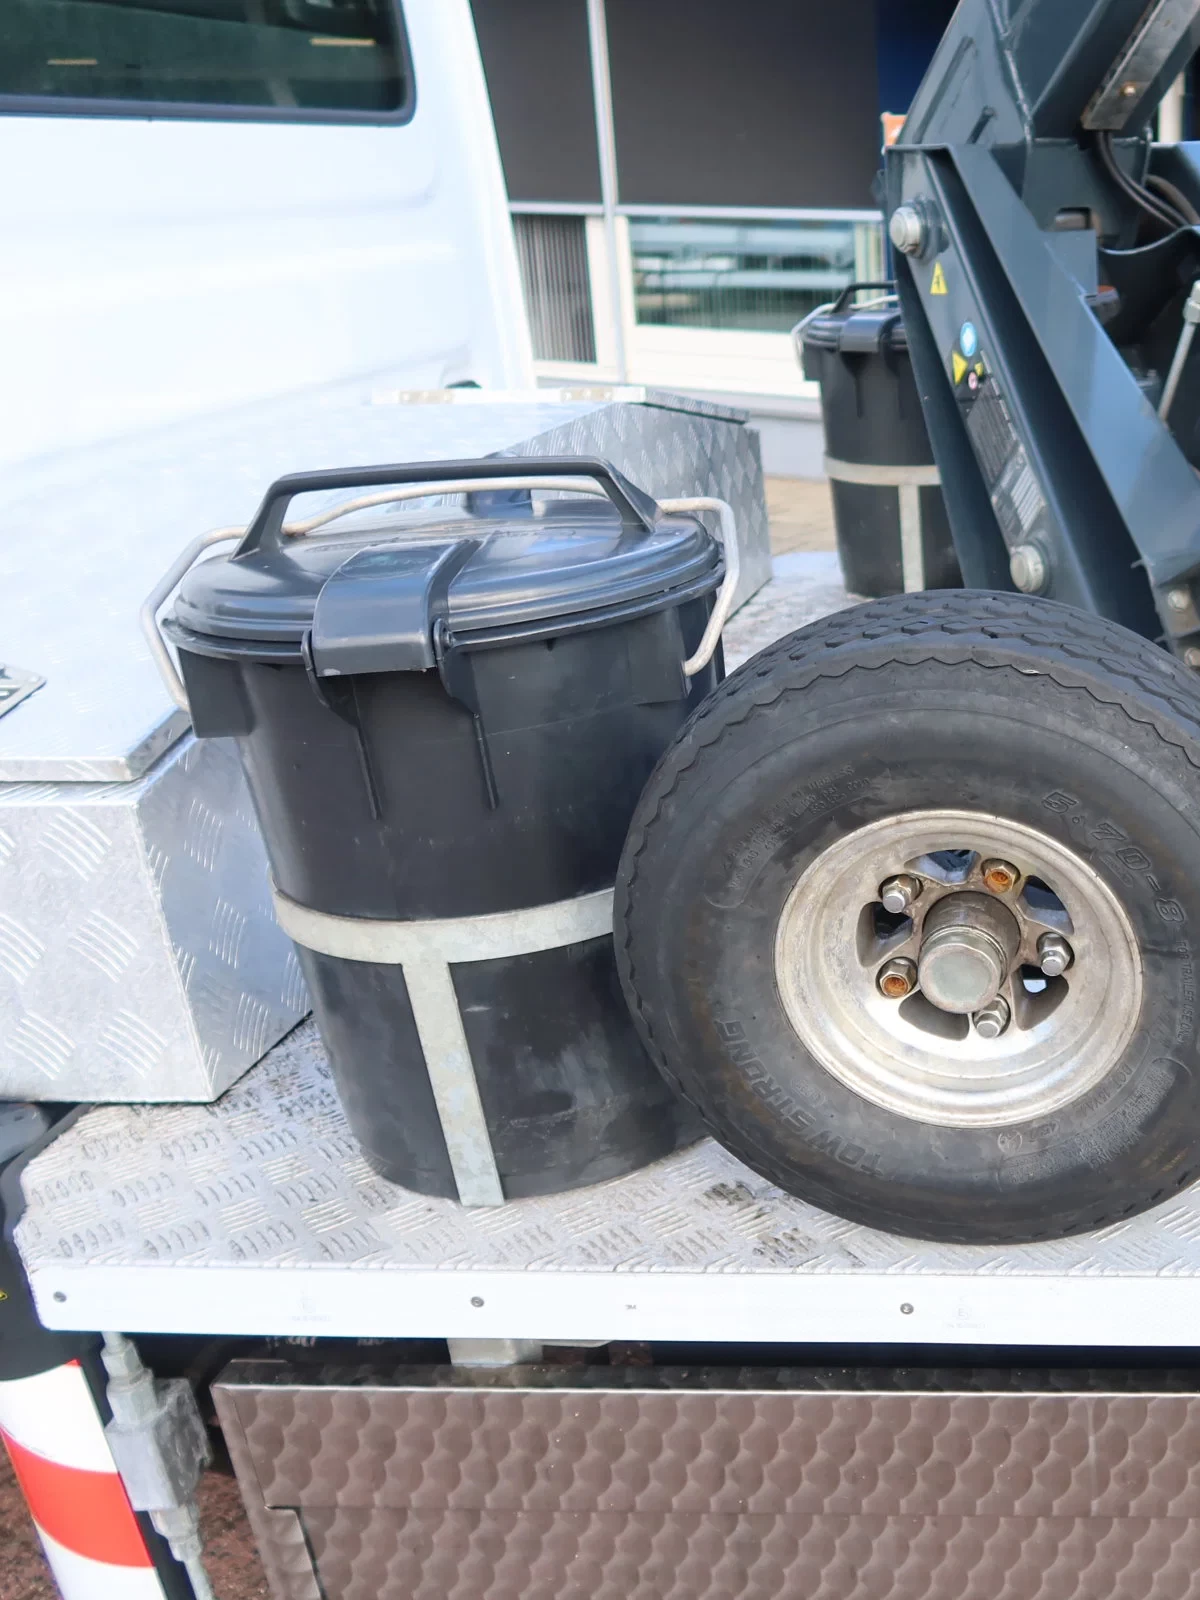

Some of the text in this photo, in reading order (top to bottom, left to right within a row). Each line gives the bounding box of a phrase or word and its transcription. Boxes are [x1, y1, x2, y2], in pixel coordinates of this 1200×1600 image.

[1174, 939, 1196, 1046] FOR TRAILER USE ONLY
[713, 1019, 885, 1177] TOWSTRONG
